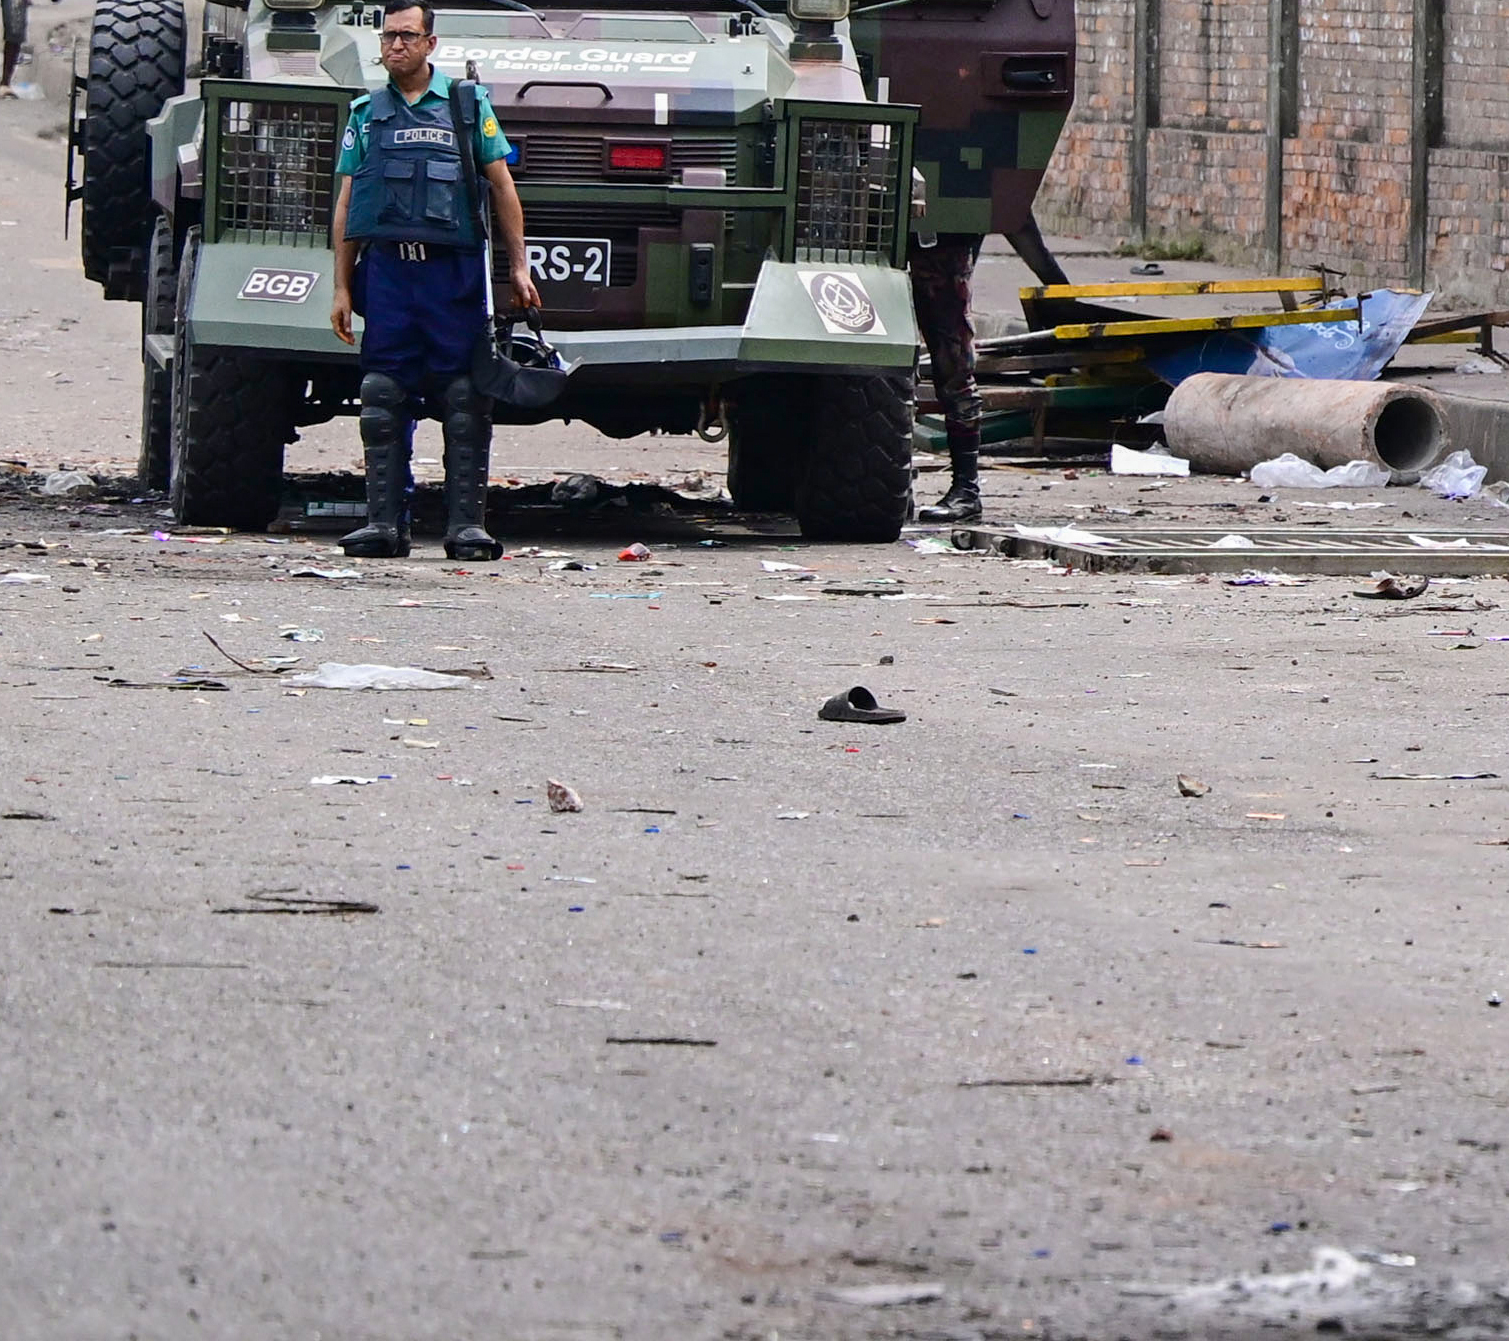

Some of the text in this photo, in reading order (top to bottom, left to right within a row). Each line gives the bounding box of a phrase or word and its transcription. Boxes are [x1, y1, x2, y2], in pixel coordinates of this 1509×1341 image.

[438, 45, 697, 65] Border Guard
[494, 60, 629, 73] Bangladesh
[403, 131, 445, 143] POLICE
[243, 272, 311, 297] BGB
